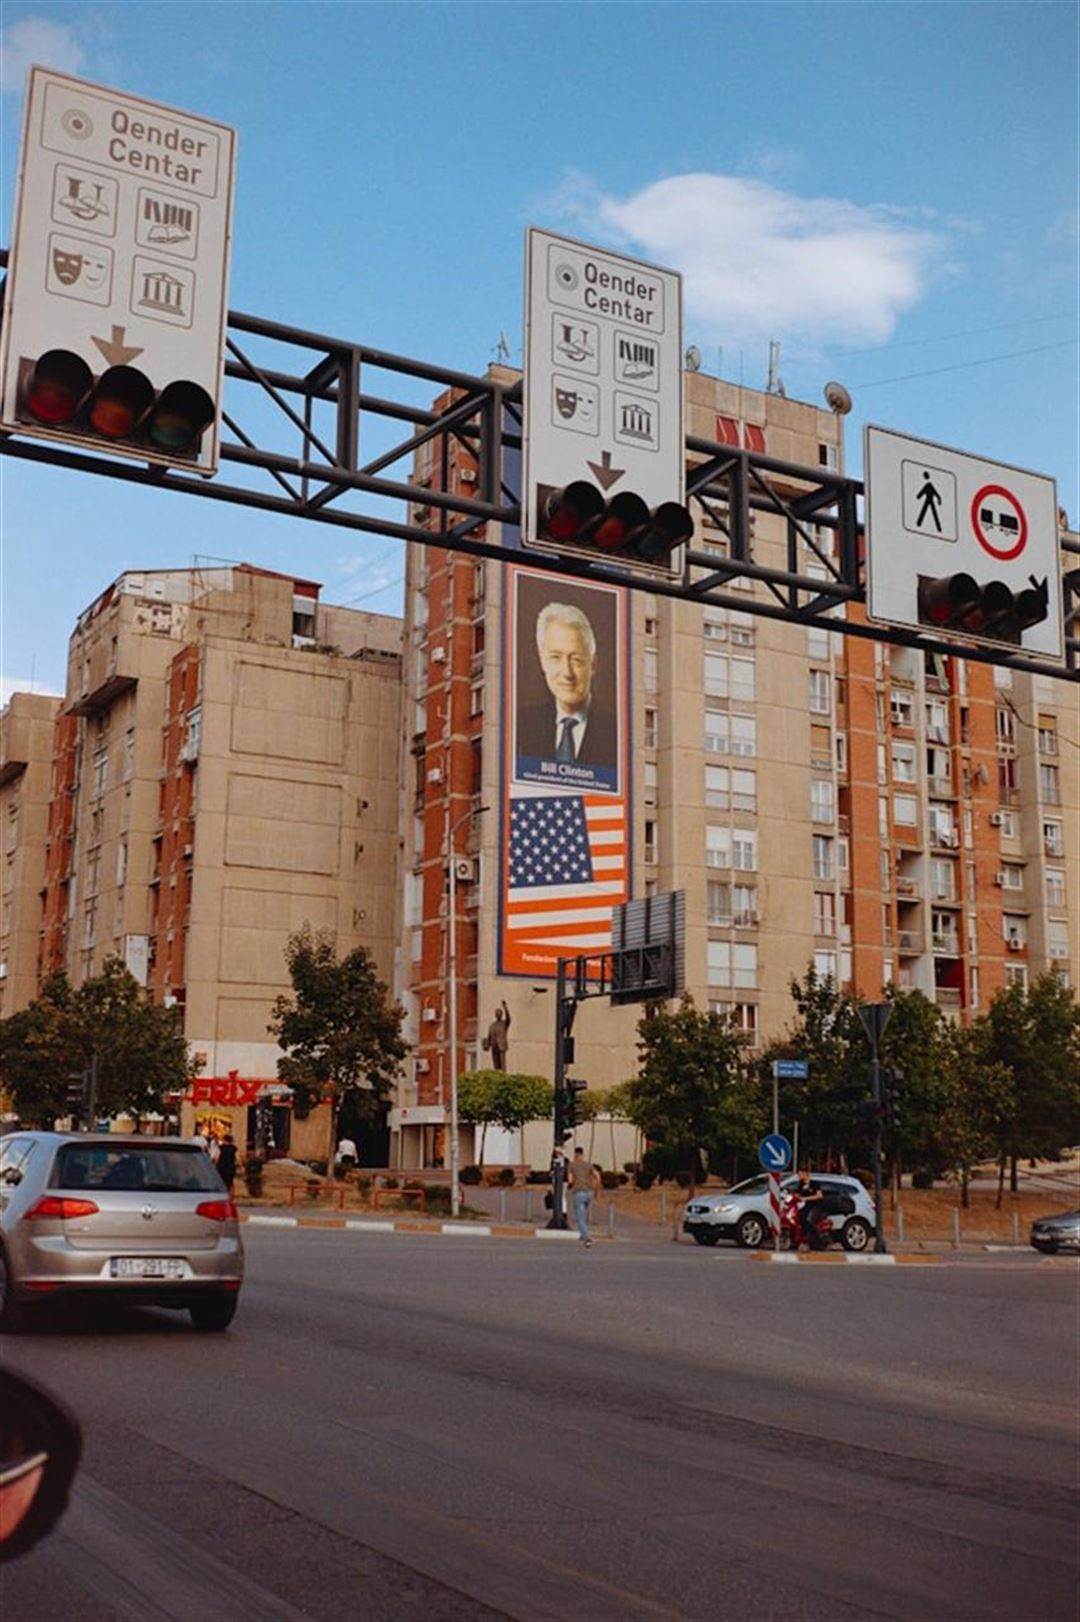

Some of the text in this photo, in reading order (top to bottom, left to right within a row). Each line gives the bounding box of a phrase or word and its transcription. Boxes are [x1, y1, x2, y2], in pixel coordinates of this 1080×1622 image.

[110, 109, 208, 158] Qender
[108, 137, 203, 185] Centar
[584, 262, 657, 301] Qender
[584, 287, 654, 325] Centar
[540, 761, 594, 779] Bill Clinton
